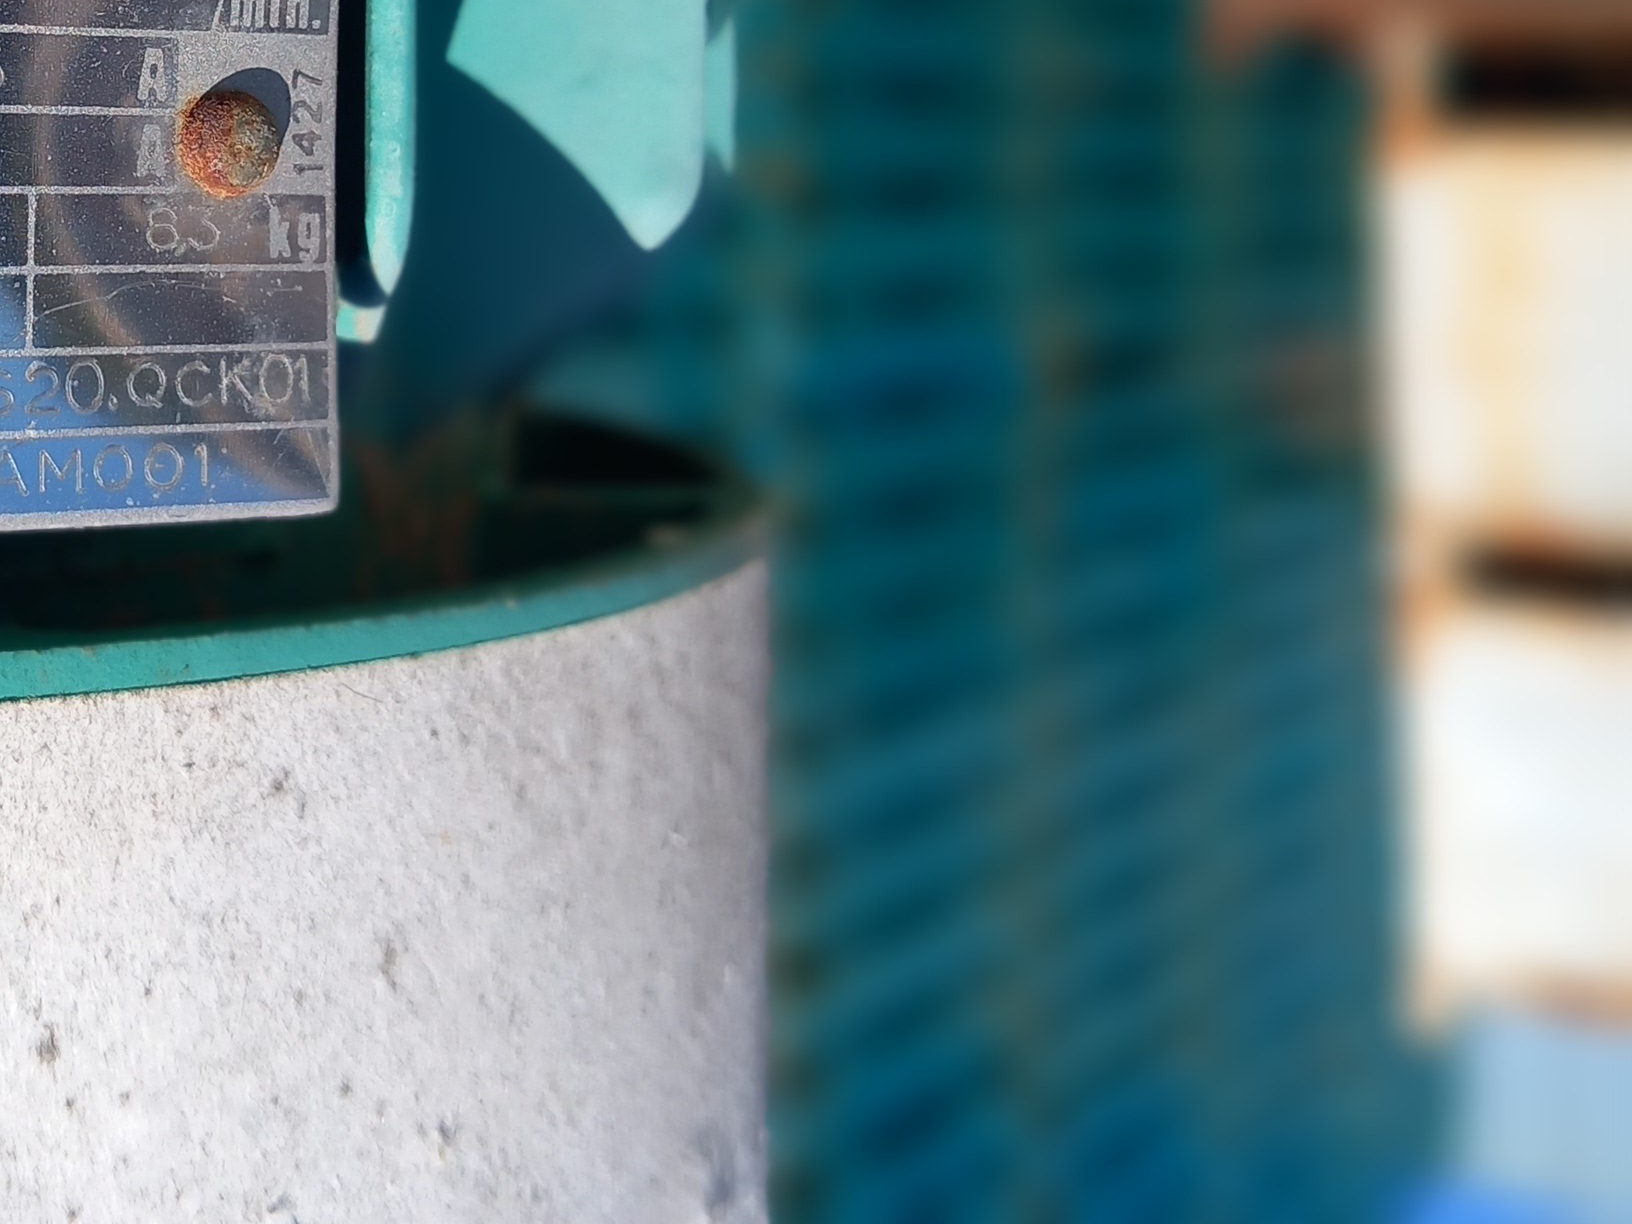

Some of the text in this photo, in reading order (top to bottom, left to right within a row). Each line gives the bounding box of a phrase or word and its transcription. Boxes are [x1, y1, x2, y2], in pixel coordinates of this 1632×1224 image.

[136, 47, 167, 102] A
[290, 68, 324, 175] 1427
[268, 206, 321, 264] kg
